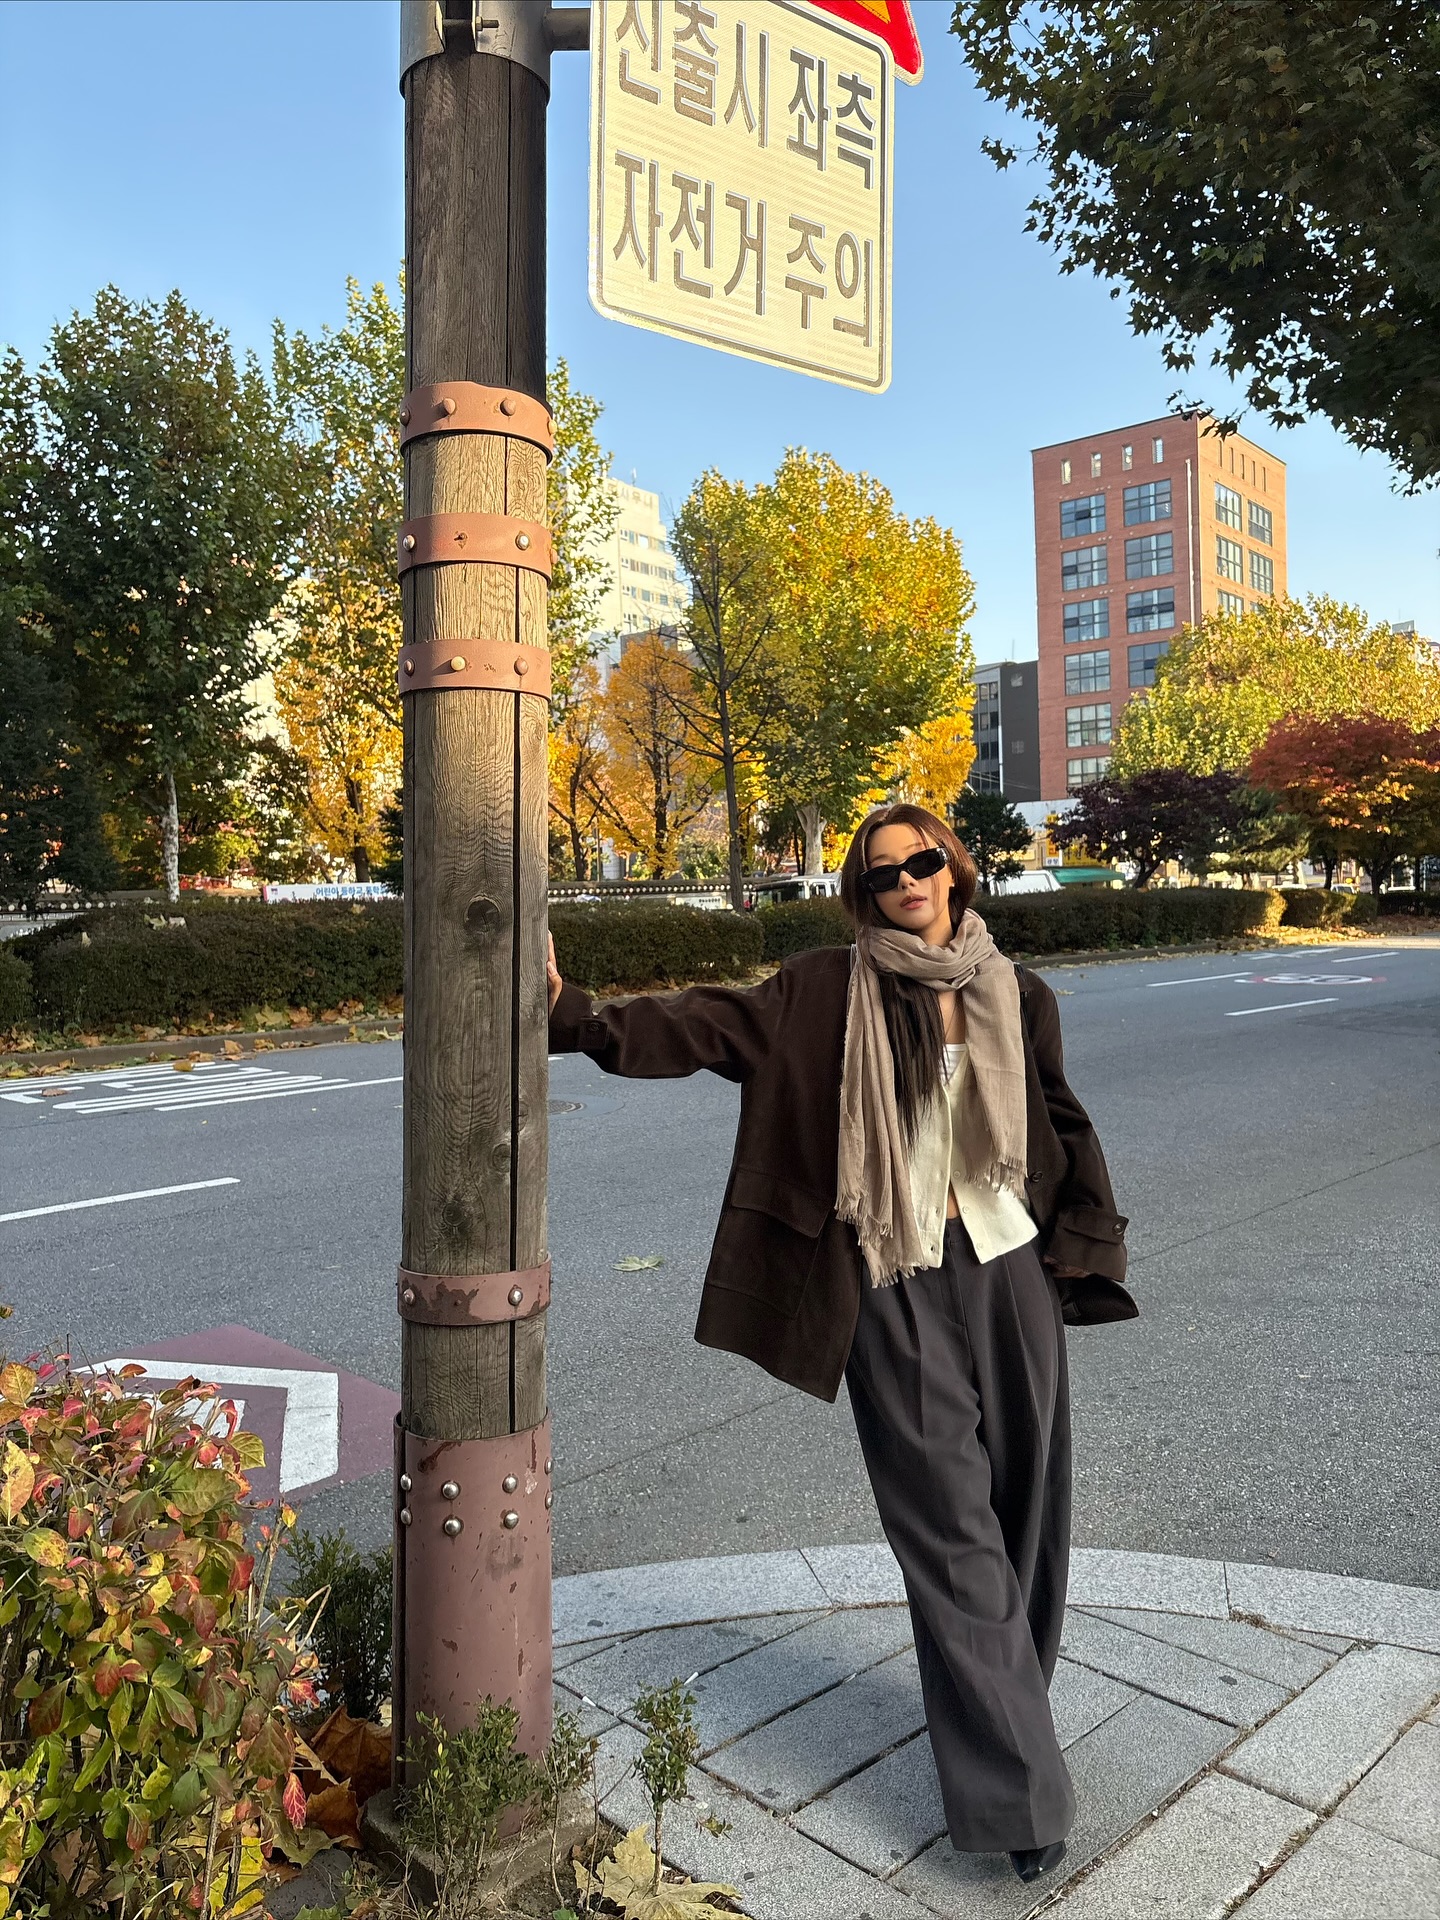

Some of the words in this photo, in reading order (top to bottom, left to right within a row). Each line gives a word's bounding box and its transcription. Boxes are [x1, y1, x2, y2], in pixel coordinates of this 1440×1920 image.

[786, 47, 876, 191] 좌측
[612, 149, 768, 317] 자전거
[784, 213, 874, 348] 주의
[315, 887, 339, 896] 어린이
